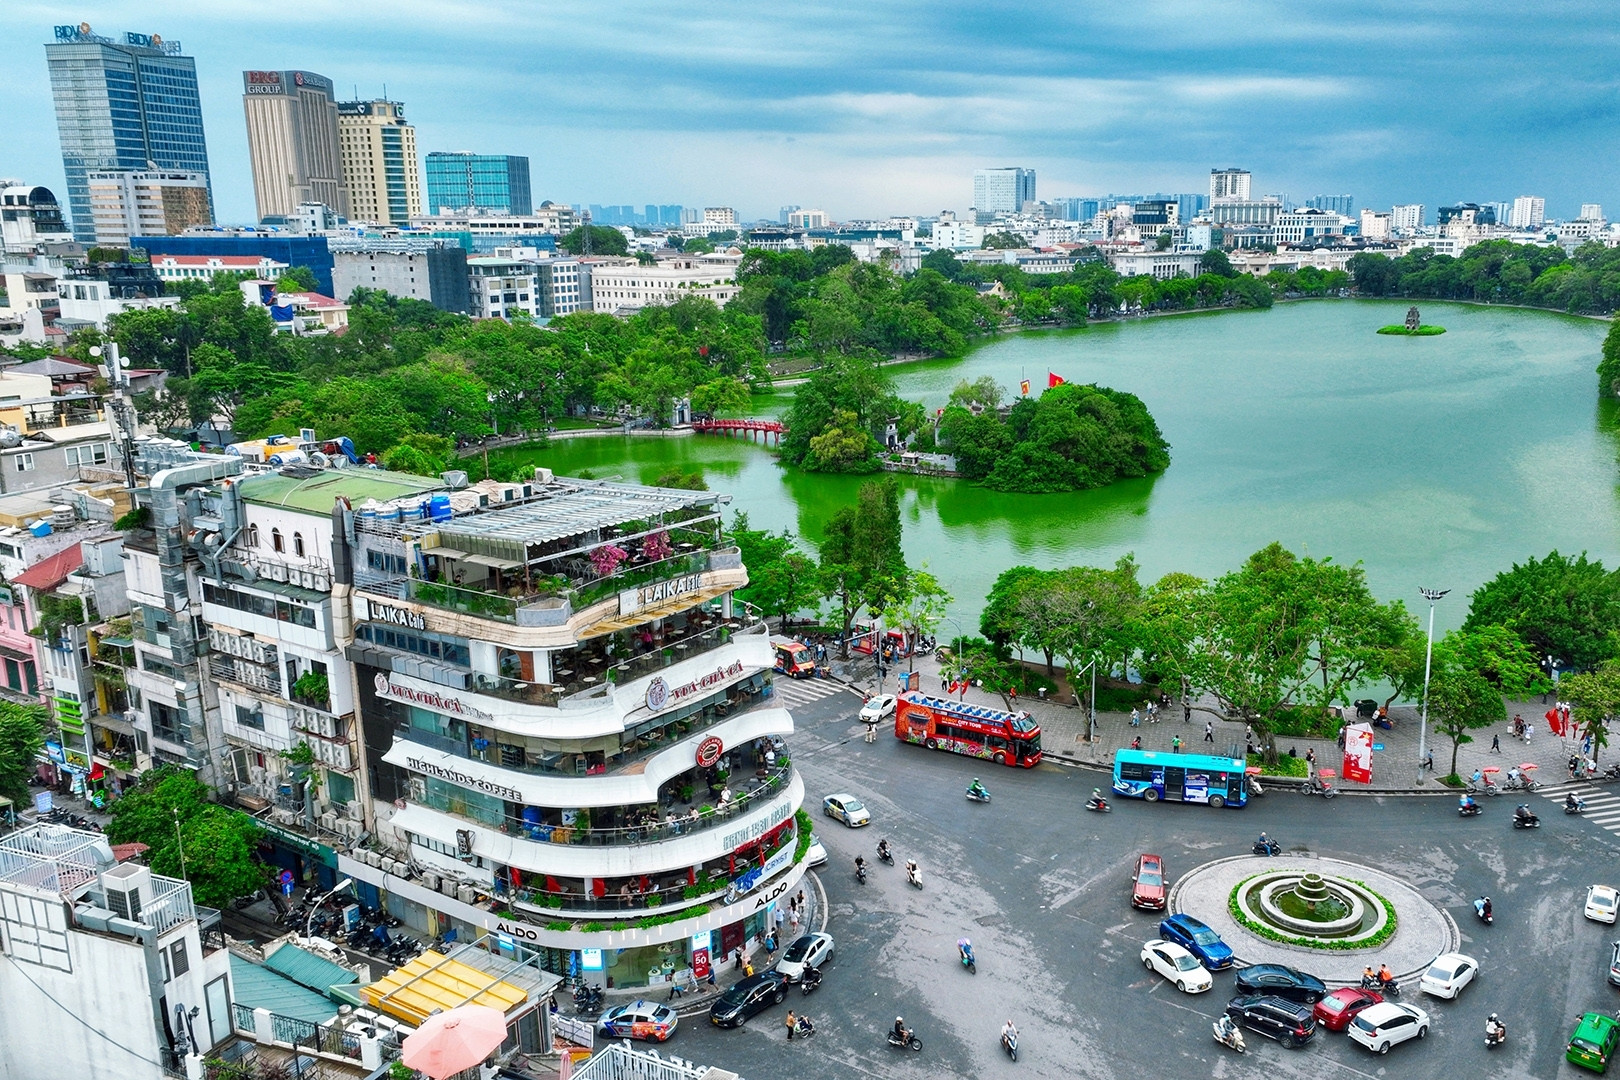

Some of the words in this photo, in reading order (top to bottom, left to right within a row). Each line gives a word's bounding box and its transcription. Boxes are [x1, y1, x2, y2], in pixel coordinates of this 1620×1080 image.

[54, 25, 80, 38] BIDV
[127, 32, 153, 46] BIDV
[248, 85, 281, 94] GROUP
[643, 579, 685, 604] LAIKA
[371, 603, 408, 626] LAIKA
[391, 685, 416, 701] VUA
[674, 681, 697, 699] VUA
[969, 721, 982, 729] TOUR
[406, 756, 474, 787] HIGHLANDS
[475, 779, 522, 801] COFFEE
[754, 882, 787, 909] ALDO
[497, 922, 538, 940] ALDO
[695, 956, 707, 965] 50
